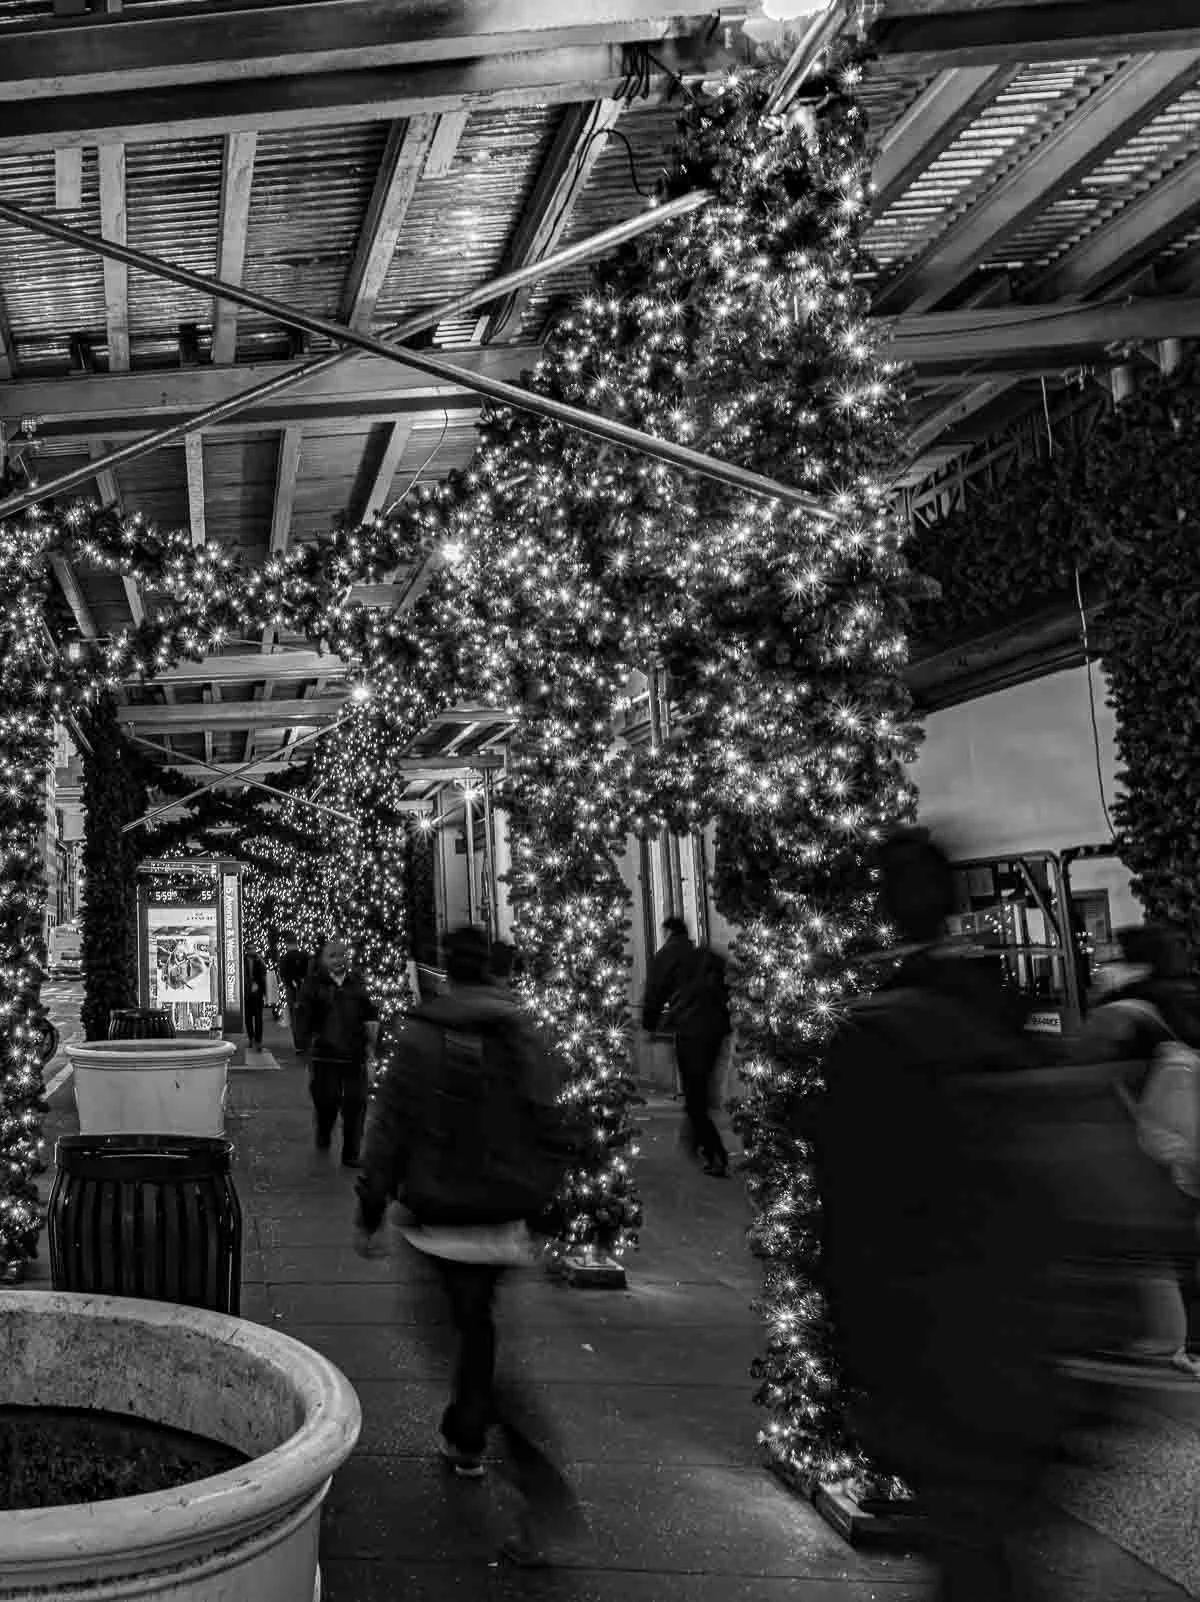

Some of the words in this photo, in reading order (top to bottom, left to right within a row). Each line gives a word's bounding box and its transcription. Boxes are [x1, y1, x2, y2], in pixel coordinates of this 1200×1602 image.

[225, 887, 234, 895] 5
[225, 895, 234, 928] Avenue
[227, 938, 235, 961] West
